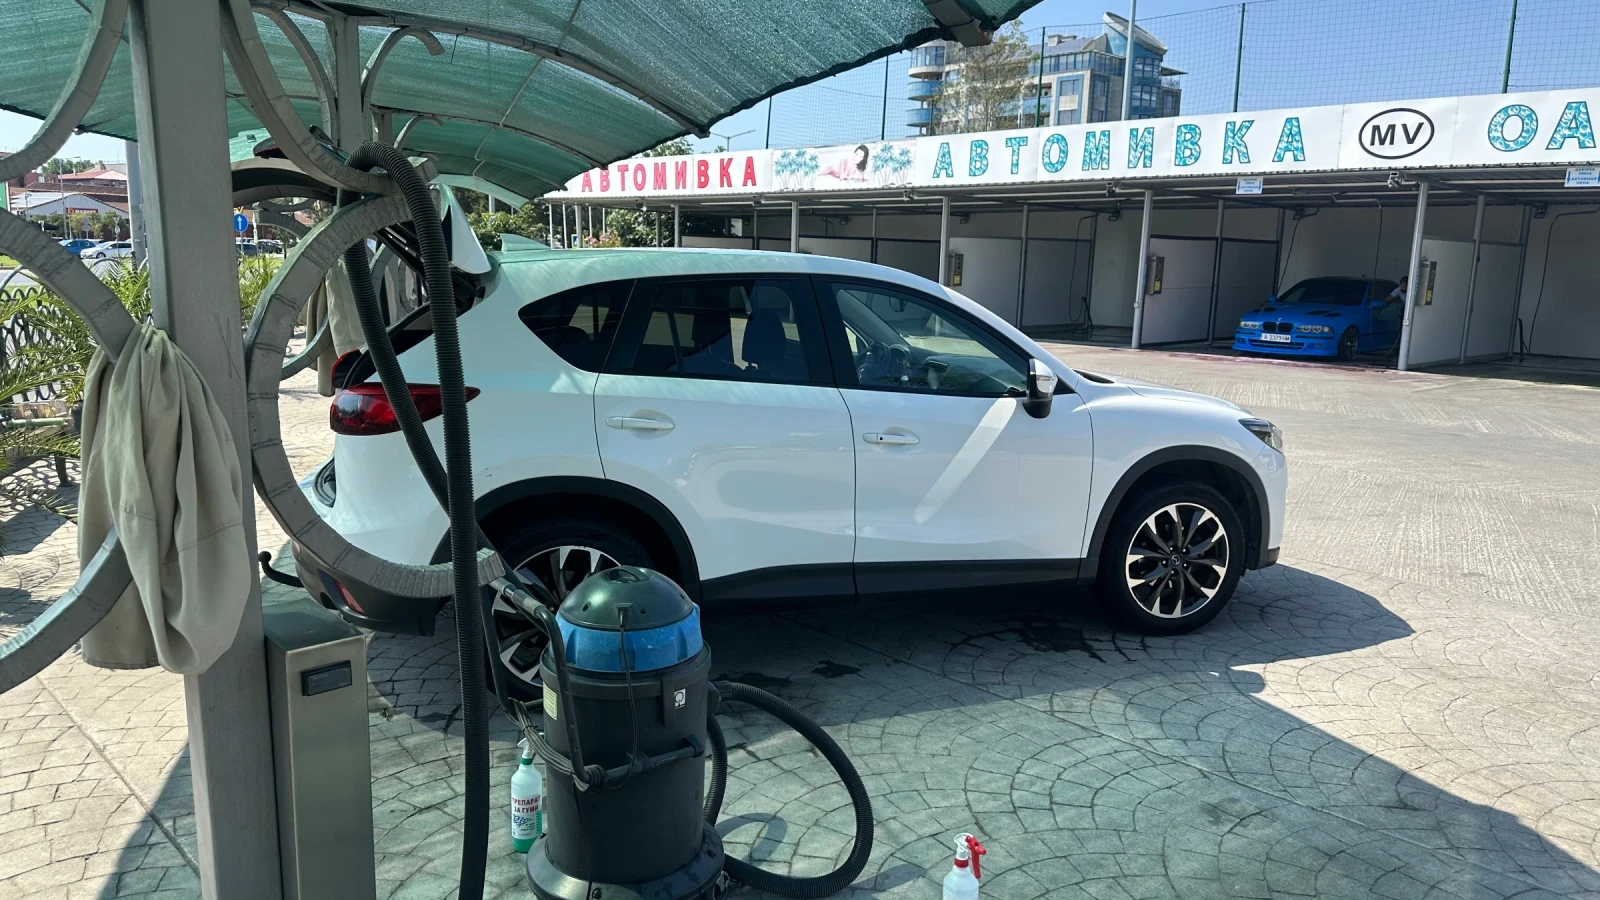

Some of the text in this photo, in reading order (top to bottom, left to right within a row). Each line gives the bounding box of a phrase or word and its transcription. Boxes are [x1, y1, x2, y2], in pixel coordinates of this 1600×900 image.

[932, 116, 1306, 179] АВТОМИВКА
[1369, 121, 1425, 147] MV
[581, 156, 758, 193] АВТОМИВКА
[522, 804, 538, 813] ГУМИ
